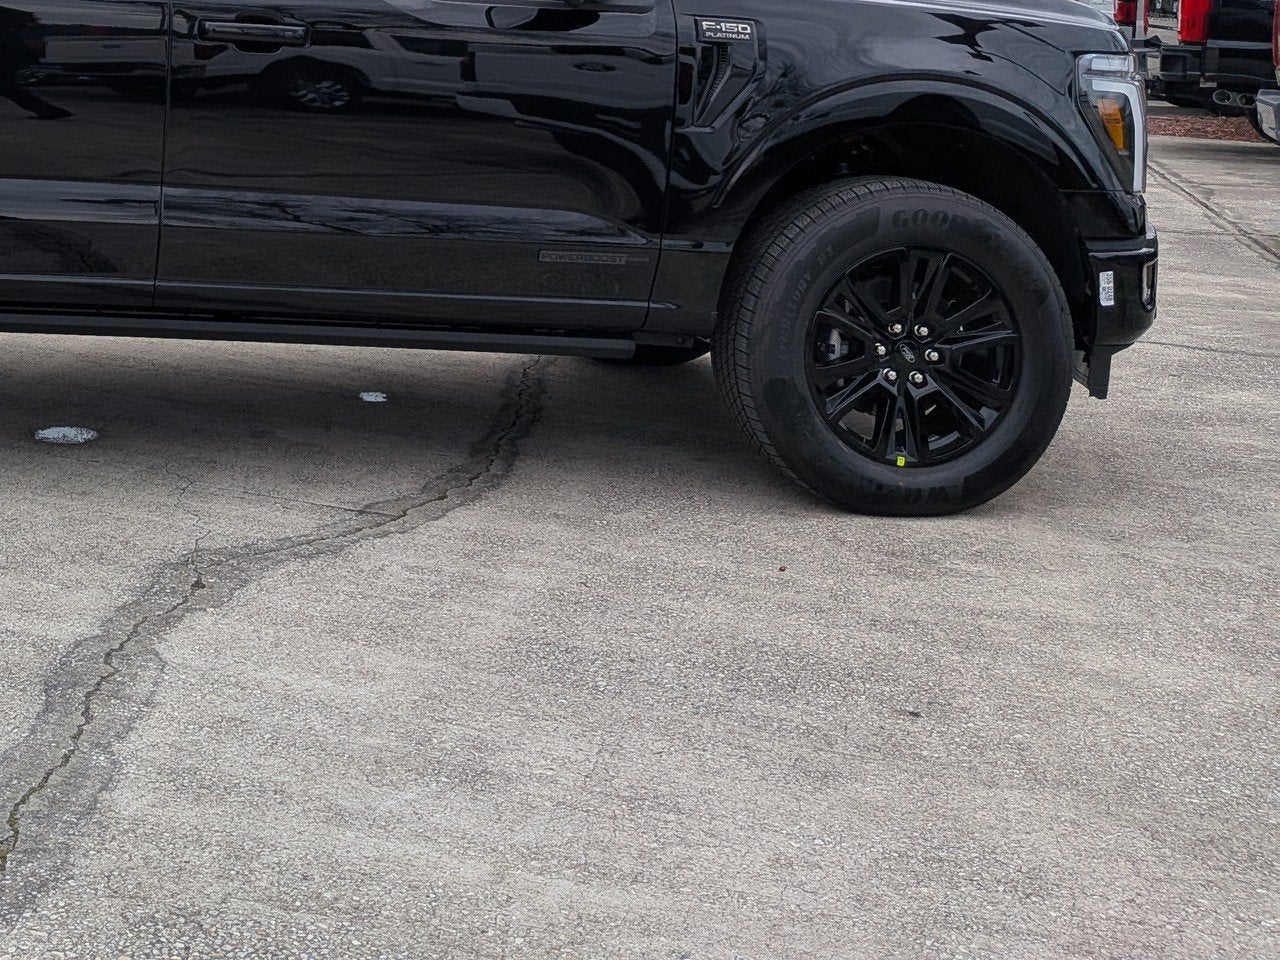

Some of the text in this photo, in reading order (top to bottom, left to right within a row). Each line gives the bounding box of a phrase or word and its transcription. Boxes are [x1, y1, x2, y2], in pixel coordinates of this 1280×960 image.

[701, 21, 751, 33] F-150
[705, 31, 750, 40] PLATINUM
[541, 252, 626, 263] POWERBOOST
